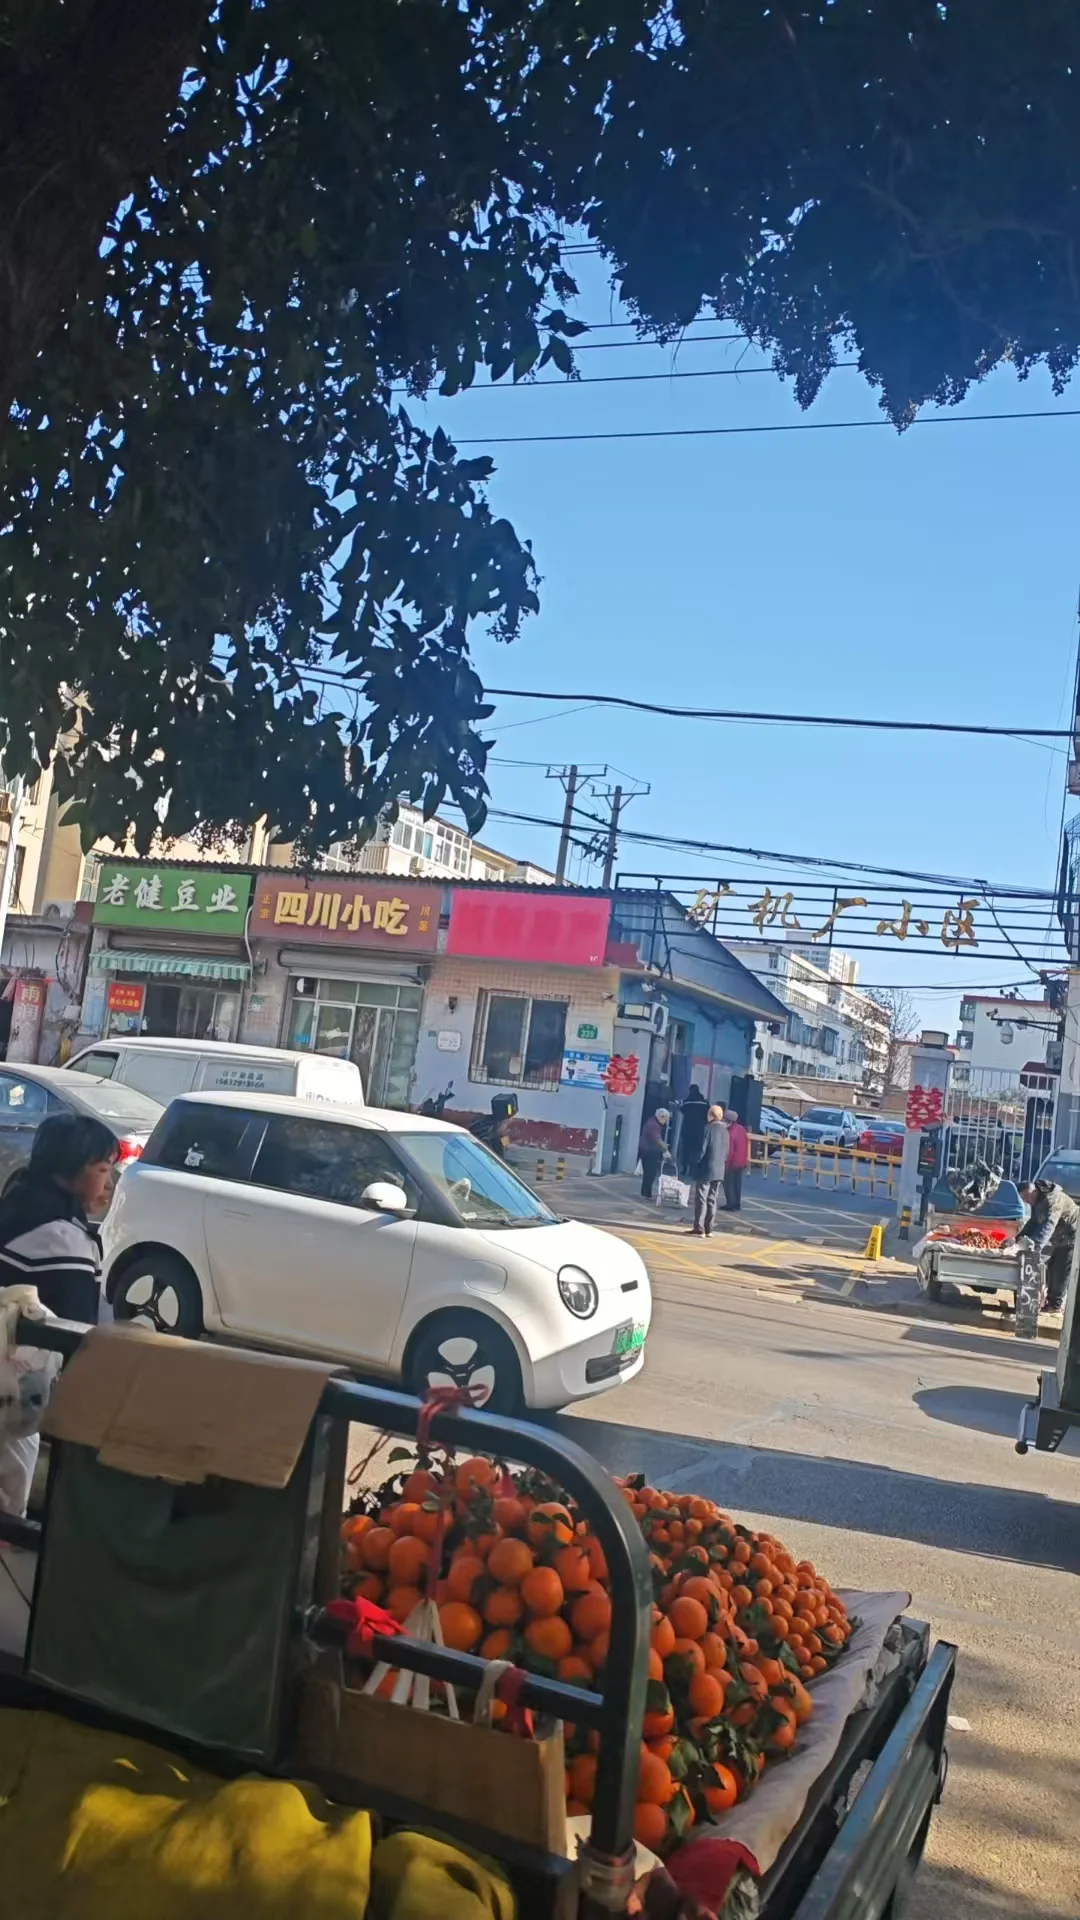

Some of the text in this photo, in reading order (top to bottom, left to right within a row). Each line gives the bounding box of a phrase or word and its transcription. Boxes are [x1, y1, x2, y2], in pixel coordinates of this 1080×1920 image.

[101, 873, 239, 913] 老健豆业
[274, 891, 410, 935] 四川小吃
[418, 904, 432, 932] 川菜
[685, 882, 979, 948] 矿机厂小区
